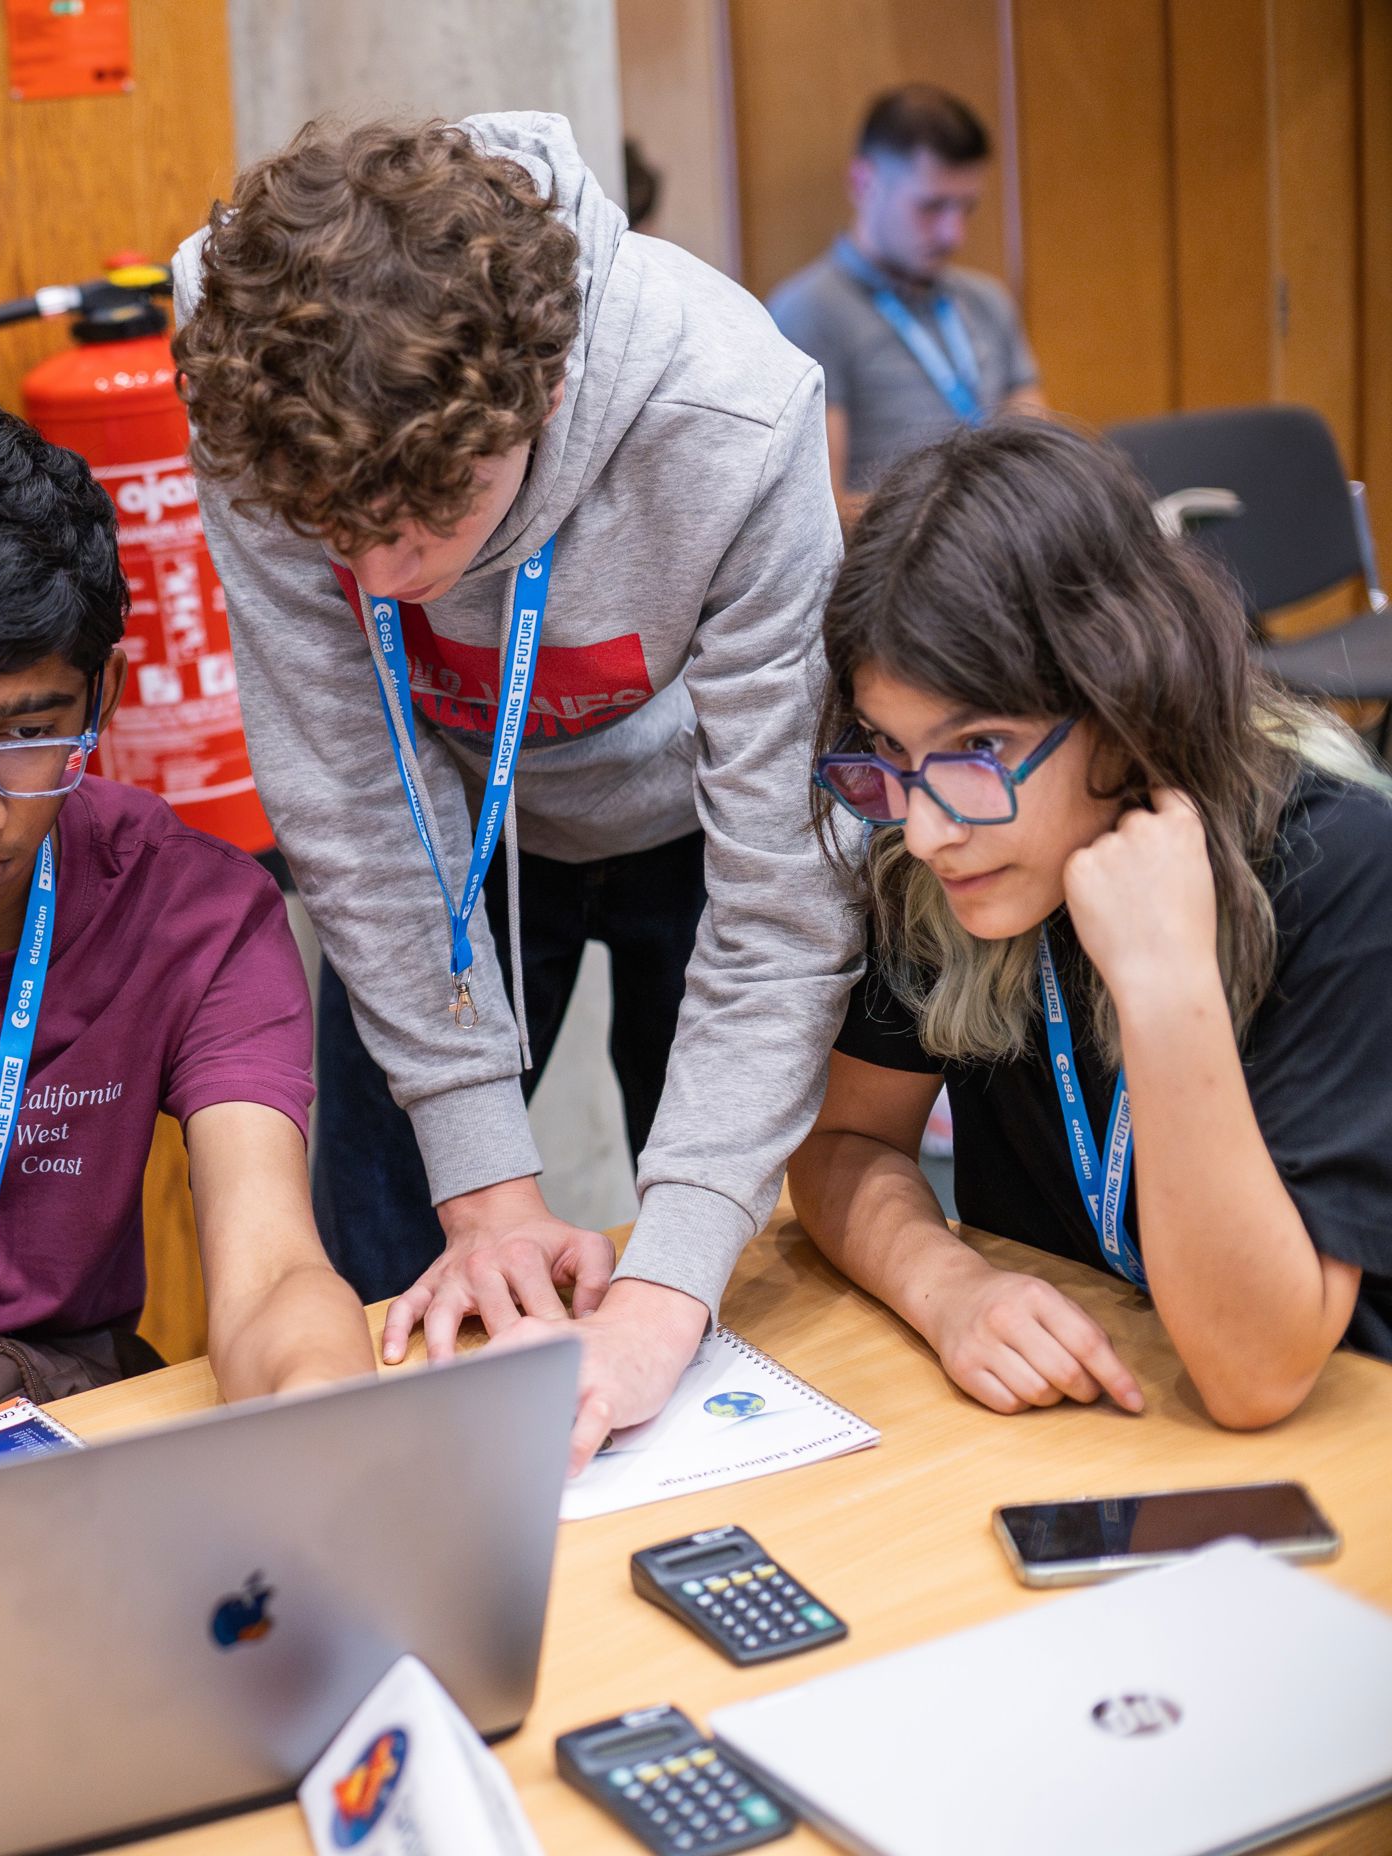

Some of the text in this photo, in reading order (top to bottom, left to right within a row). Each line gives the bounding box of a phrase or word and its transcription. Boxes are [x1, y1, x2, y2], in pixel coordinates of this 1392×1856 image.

[498, 613, 534, 770] INSPIRING THE FUTURE
[480, 801, 500, 859] education
[29, 905, 47, 965] education
[1044, 967, 1058, 1018] FUTURE
[0, 1061, 19, 1110] FUTURE
[16, 1123, 70, 1146] West
[1072, 1119, 1092, 1180] education
[1111, 1149, 1122, 1173] THE
[21, 1155, 83, 1175] Coast
[1105, 1175, 1119, 1242] INSPIRING
[658, 1430, 852, 1487] Ground station coverage
